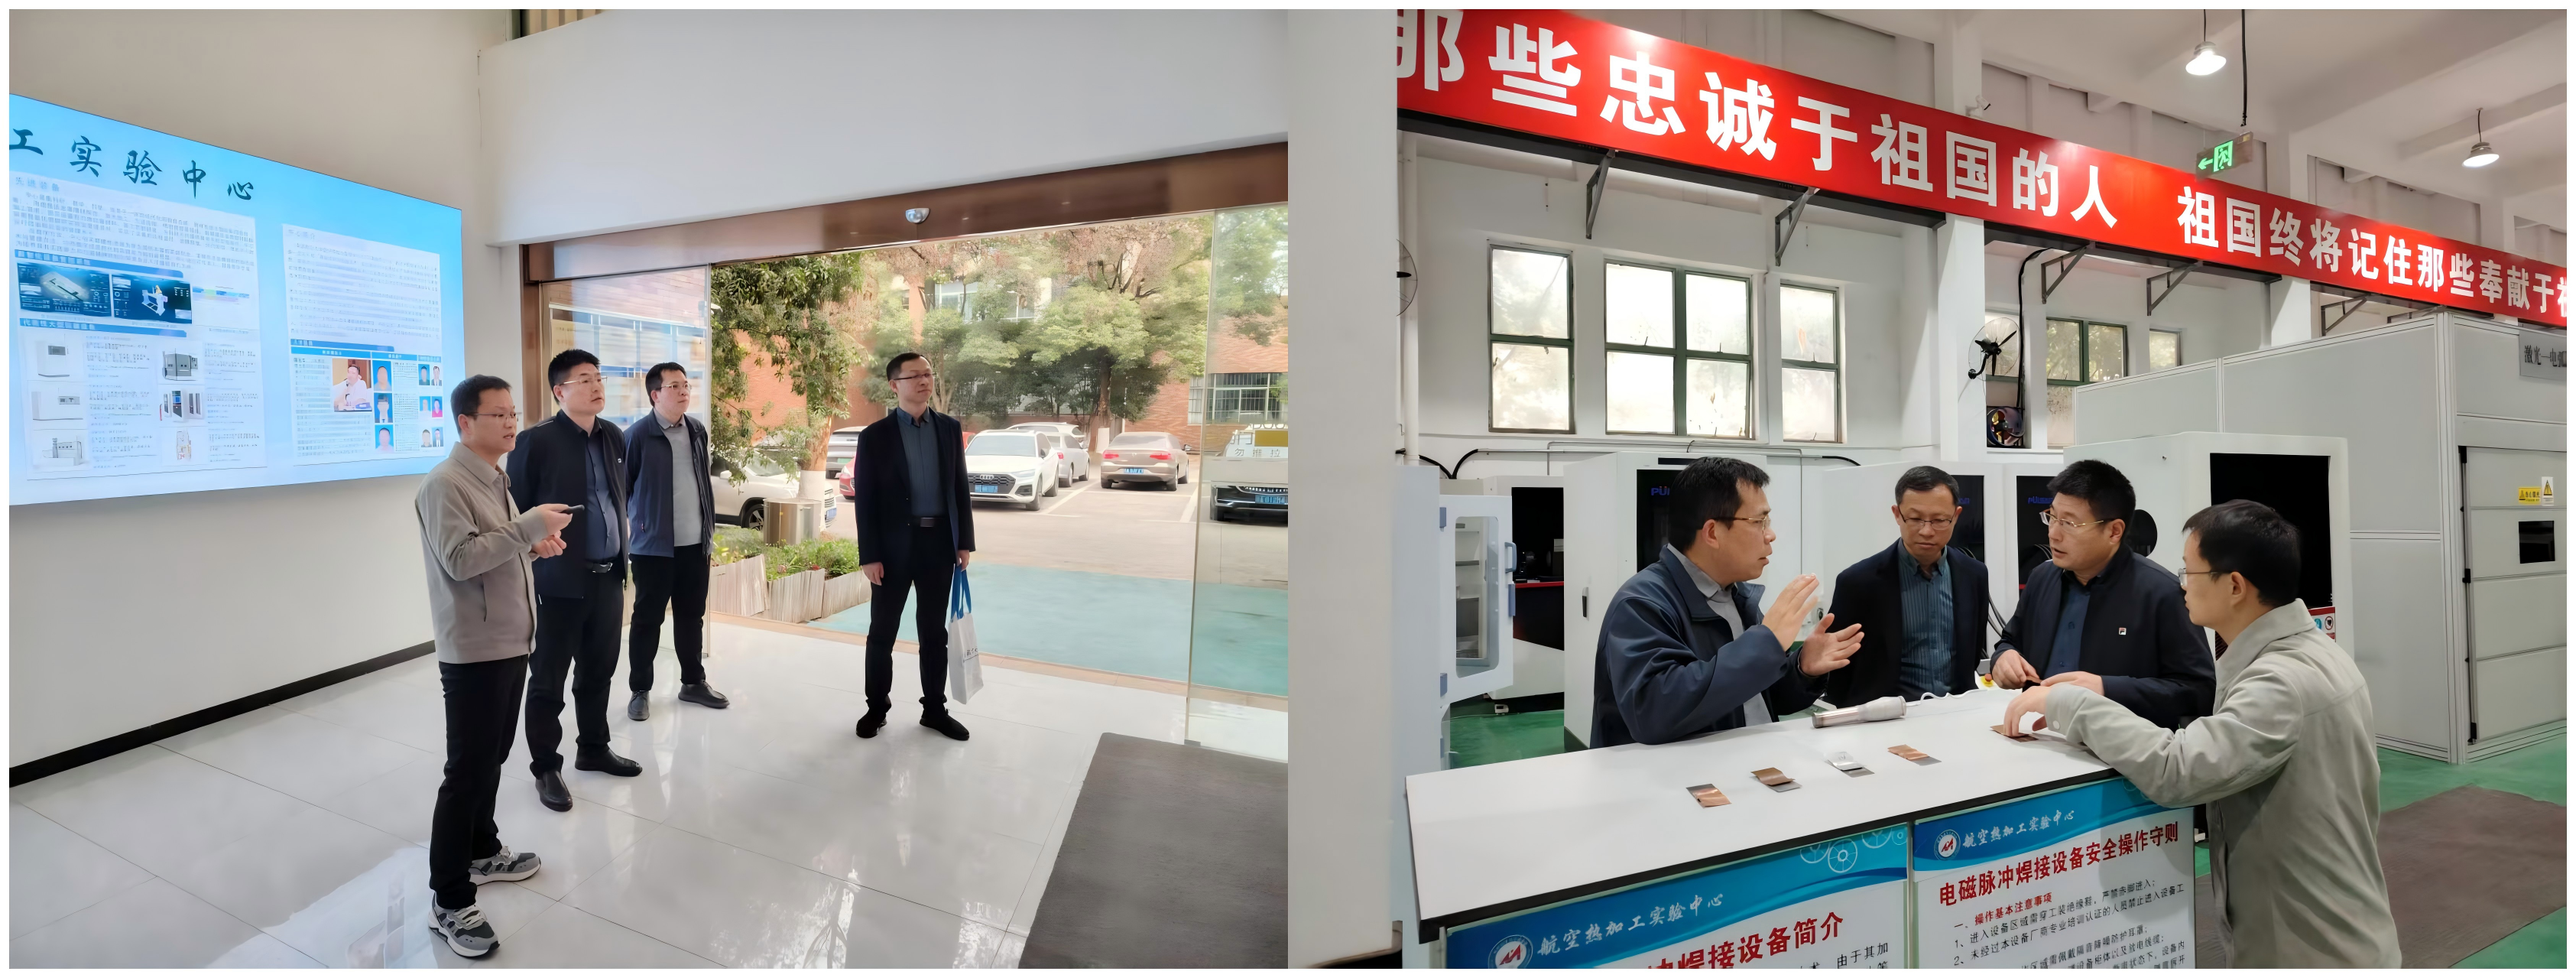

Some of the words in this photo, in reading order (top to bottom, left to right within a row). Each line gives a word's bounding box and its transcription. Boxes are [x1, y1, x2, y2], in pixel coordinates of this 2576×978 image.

[1397, 9, 2117, 229] 那些忠诚于祖国的人
[9, 128, 255, 201] 工实验中心
[1939, 821, 2179, 907] 电磁脉冲焊接设备安全操作守则
[1962, 810, 2075, 848] 航空热加工实验中心
[1536, 893, 1724, 956] 航空热加工实验中心
